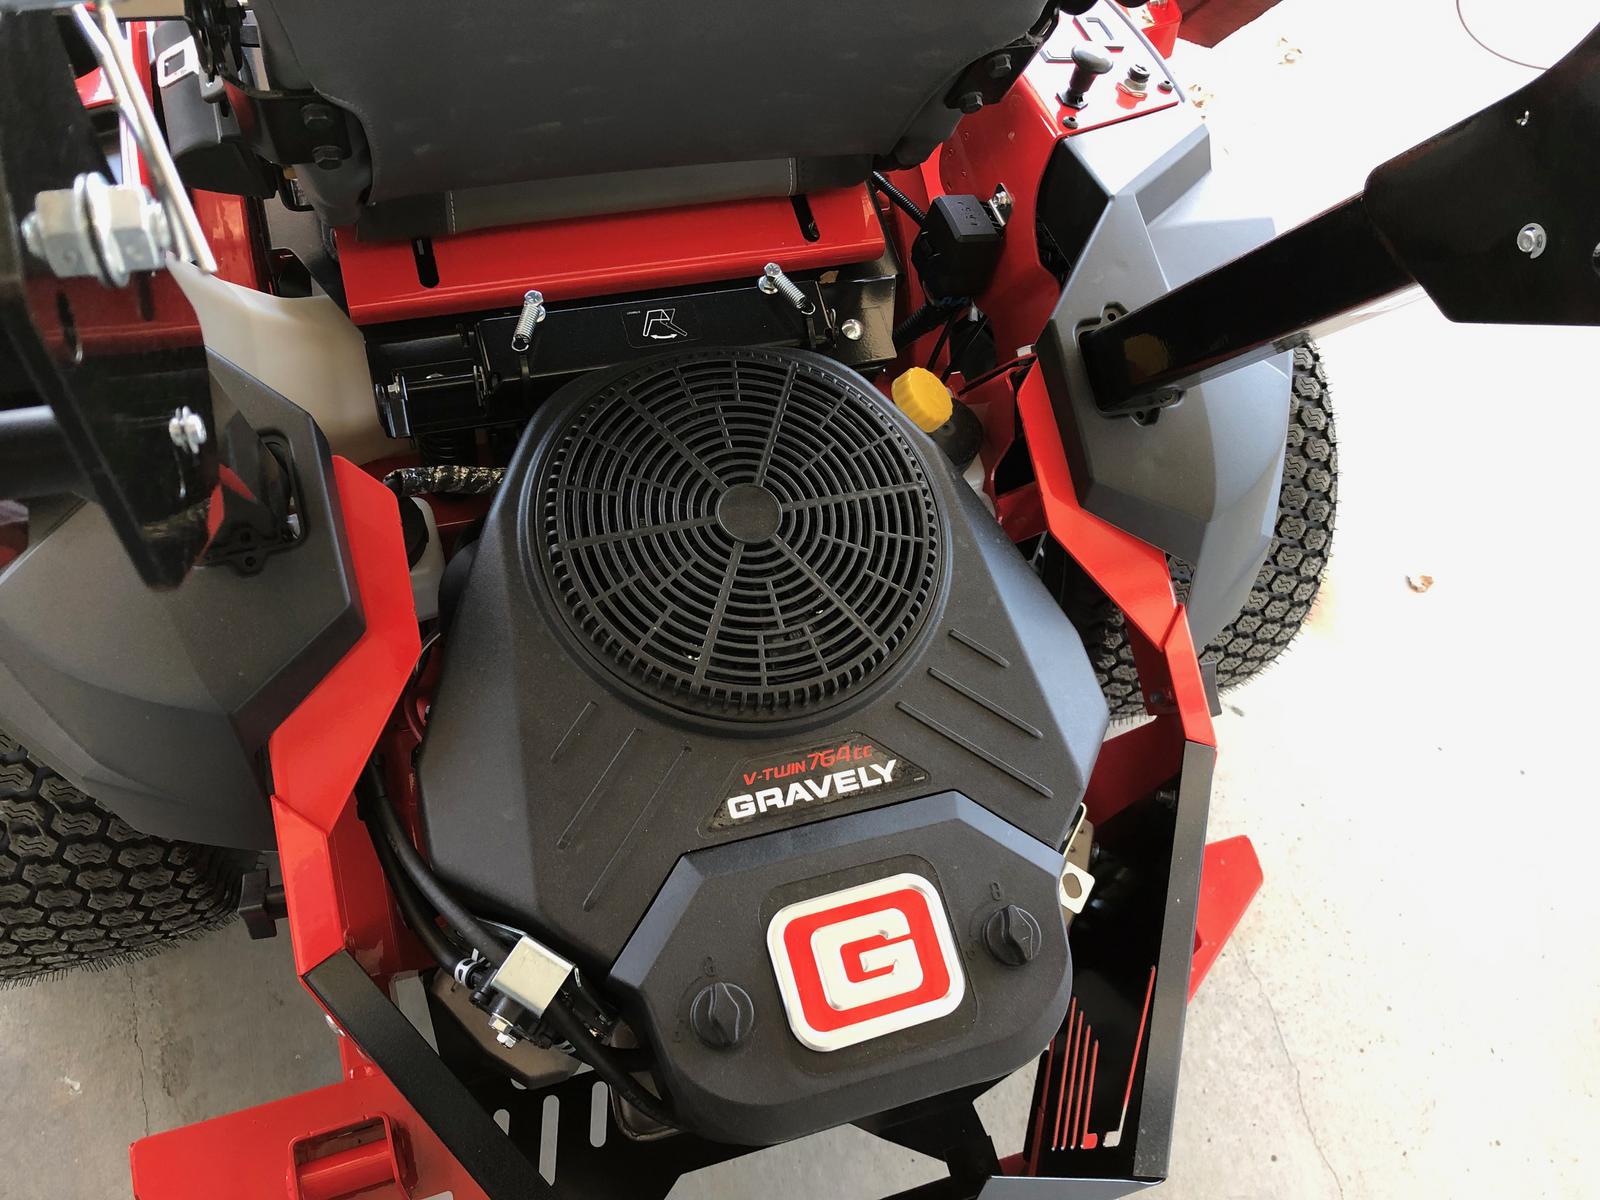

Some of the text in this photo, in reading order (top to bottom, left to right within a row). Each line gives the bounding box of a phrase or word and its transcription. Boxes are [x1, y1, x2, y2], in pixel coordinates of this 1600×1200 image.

[726, 758, 897, 820] GRAVELY
[743, 759, 806, 786] V-TWIN
[810, 907, 924, 1012] G
